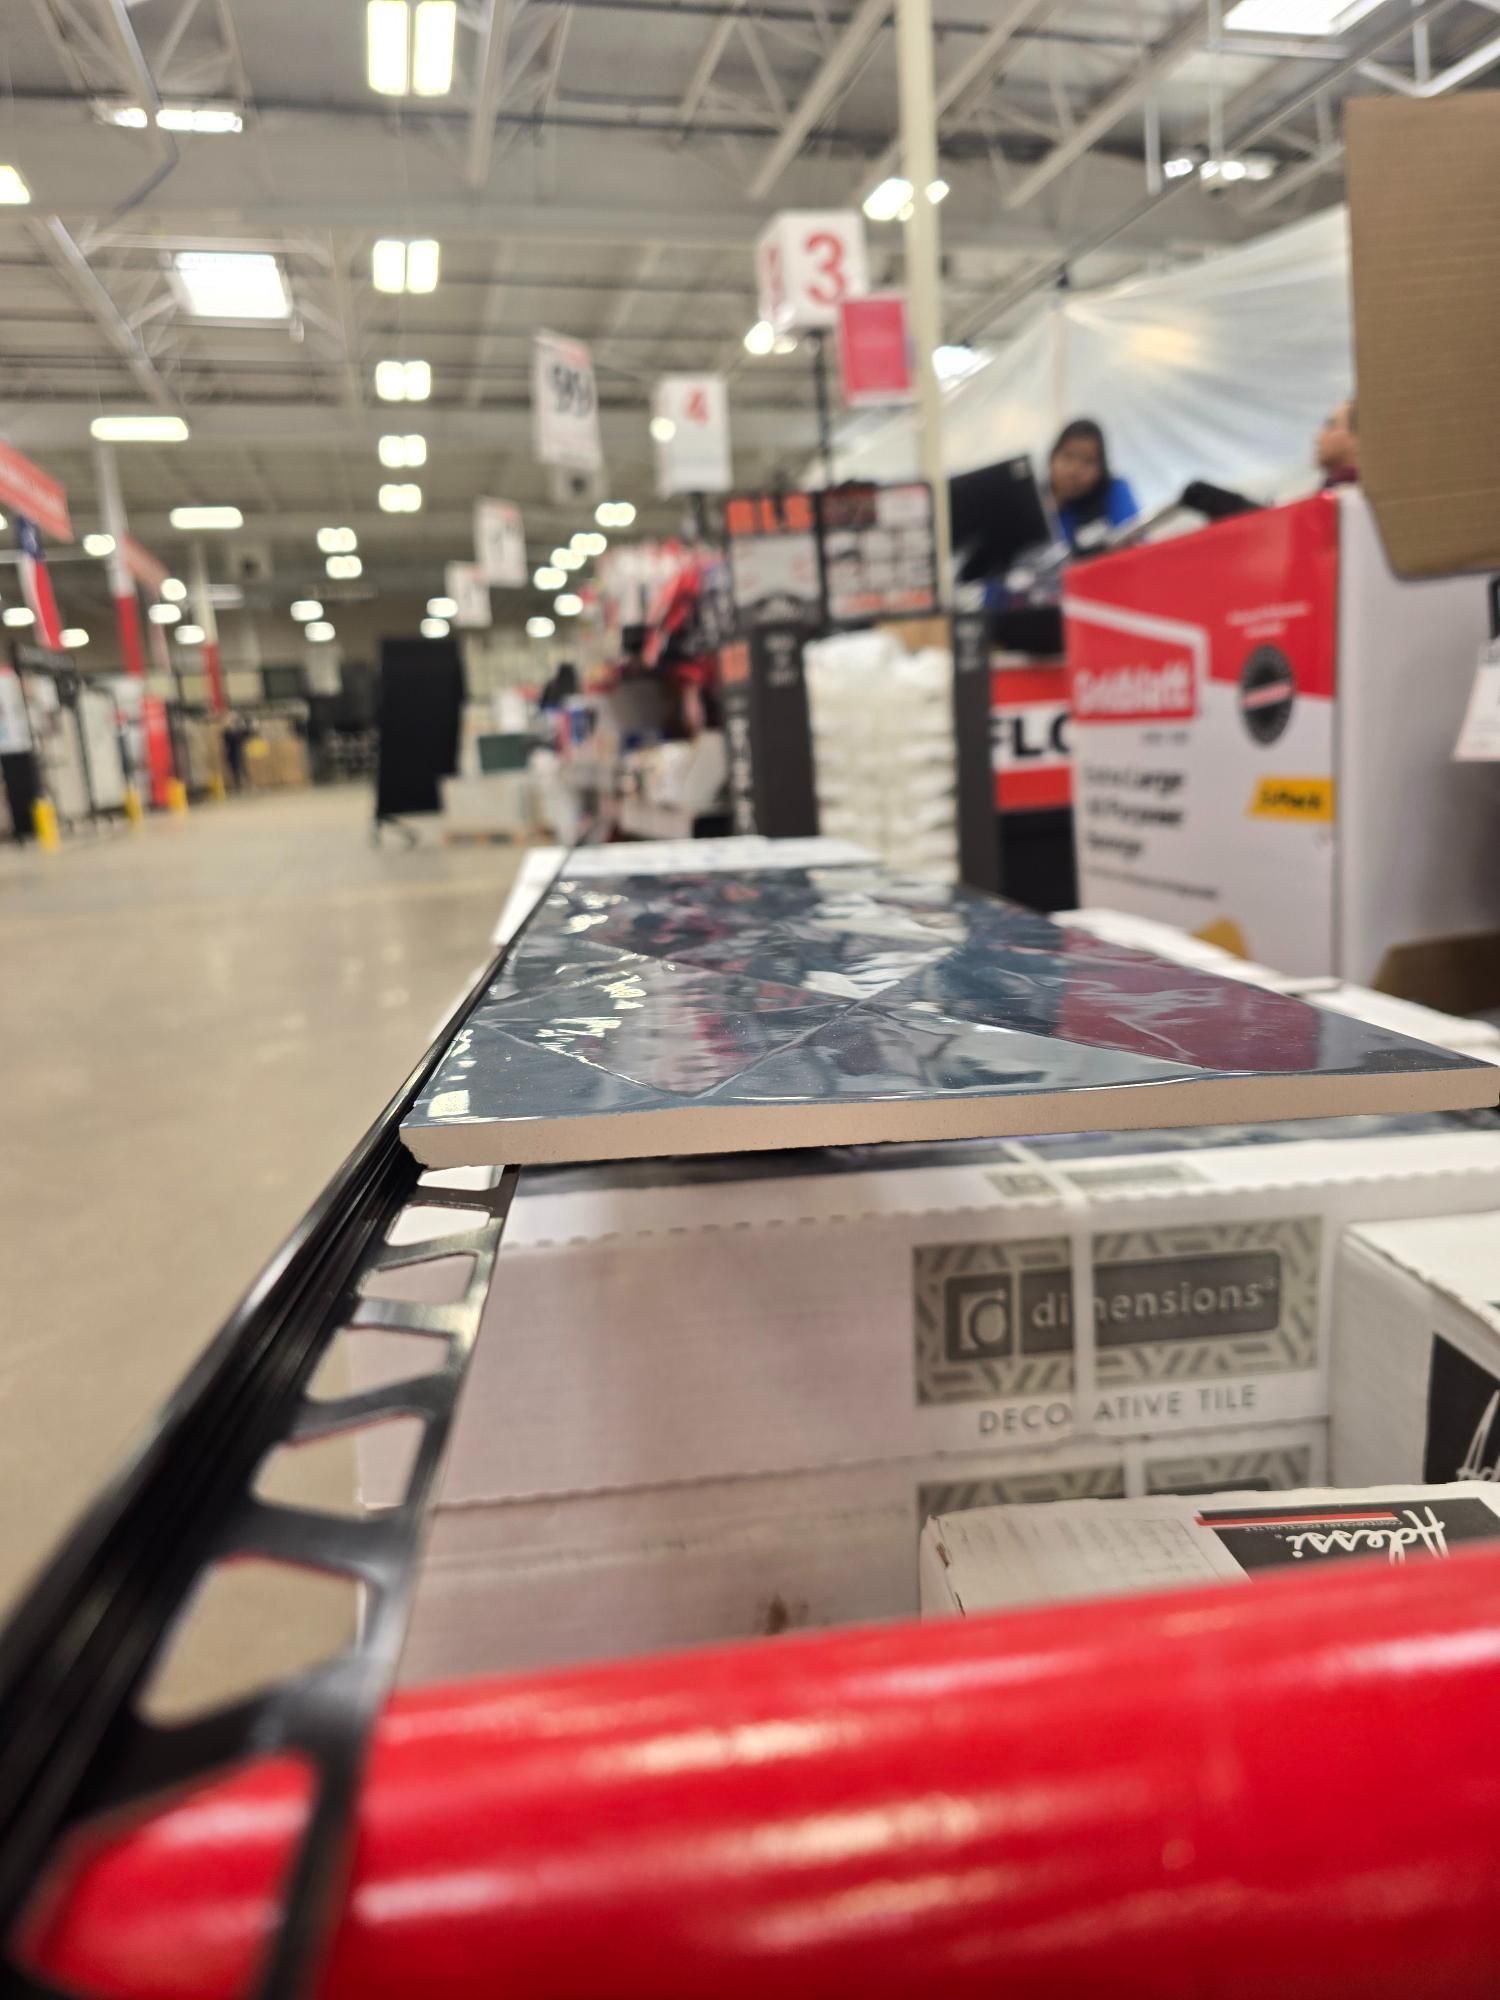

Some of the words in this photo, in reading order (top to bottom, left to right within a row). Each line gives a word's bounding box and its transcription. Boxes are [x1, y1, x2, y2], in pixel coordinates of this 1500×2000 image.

[803, 231, 847, 305] 3
[685, 387, 710, 427] 4
[978, 1390, 1184, 1435] DECOATIVE
[1196, 1384, 1259, 1412] TILE
